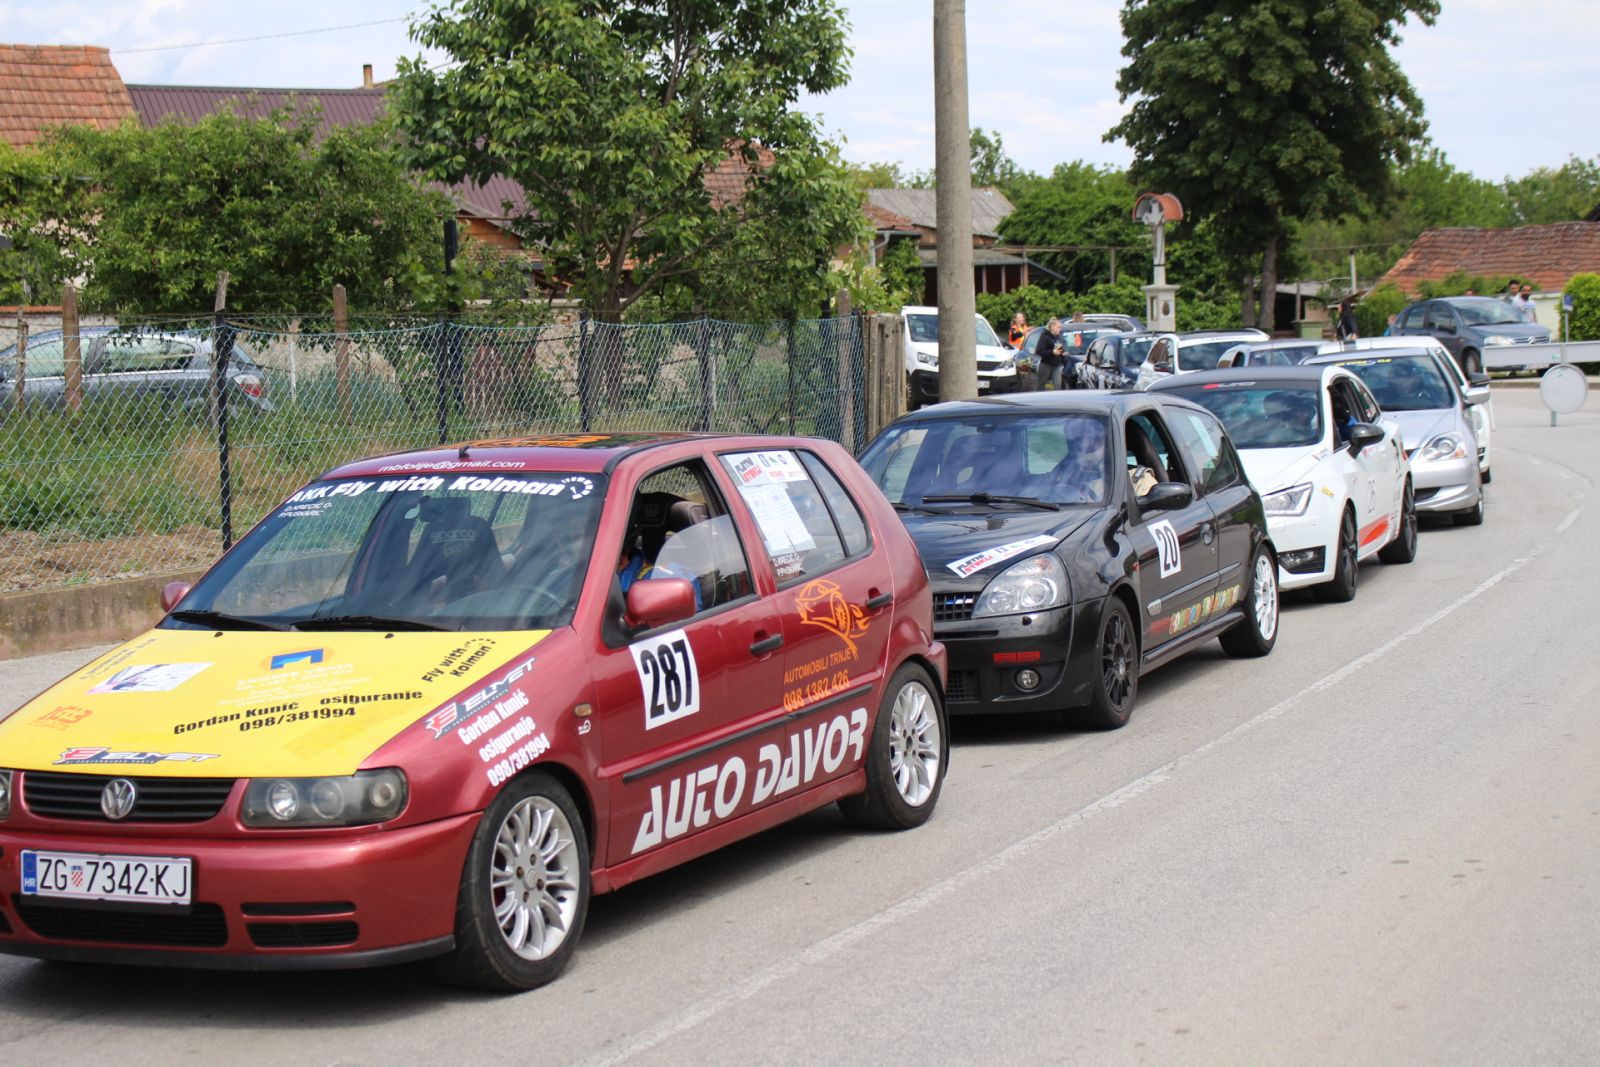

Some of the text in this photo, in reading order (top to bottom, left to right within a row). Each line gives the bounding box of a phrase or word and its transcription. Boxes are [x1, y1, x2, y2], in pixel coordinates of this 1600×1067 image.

[378, 460, 526, 472] mbfolije@gmail.com
[328, 481, 376, 497] Fly
[376, 476, 445, 492] with
[448, 476, 566, 496] Kolman
[1154, 525, 1178, 571] 20
[421, 647, 466, 683] Fly with
[450, 645, 492, 677] Kolman
[640, 638, 692, 720] 287
[783, 646, 852, 685] AUTOMOBILI TRNJE
[783, 668, 850, 712] 098 1382 426
[173, 711, 241, 735] Gordan
[245, 701, 300, 718] Kunić
[239, 706, 357, 732] 098/381994
[457, 688, 529, 745] Gordan Kunić
[478, 716, 536, 763] osiguranje
[486, 732, 551, 788] 098/381994
[630, 707, 868, 855] AUTO DAVOR
[24, 877, 37, 888] HR
[39, 858, 67, 891] ZG
